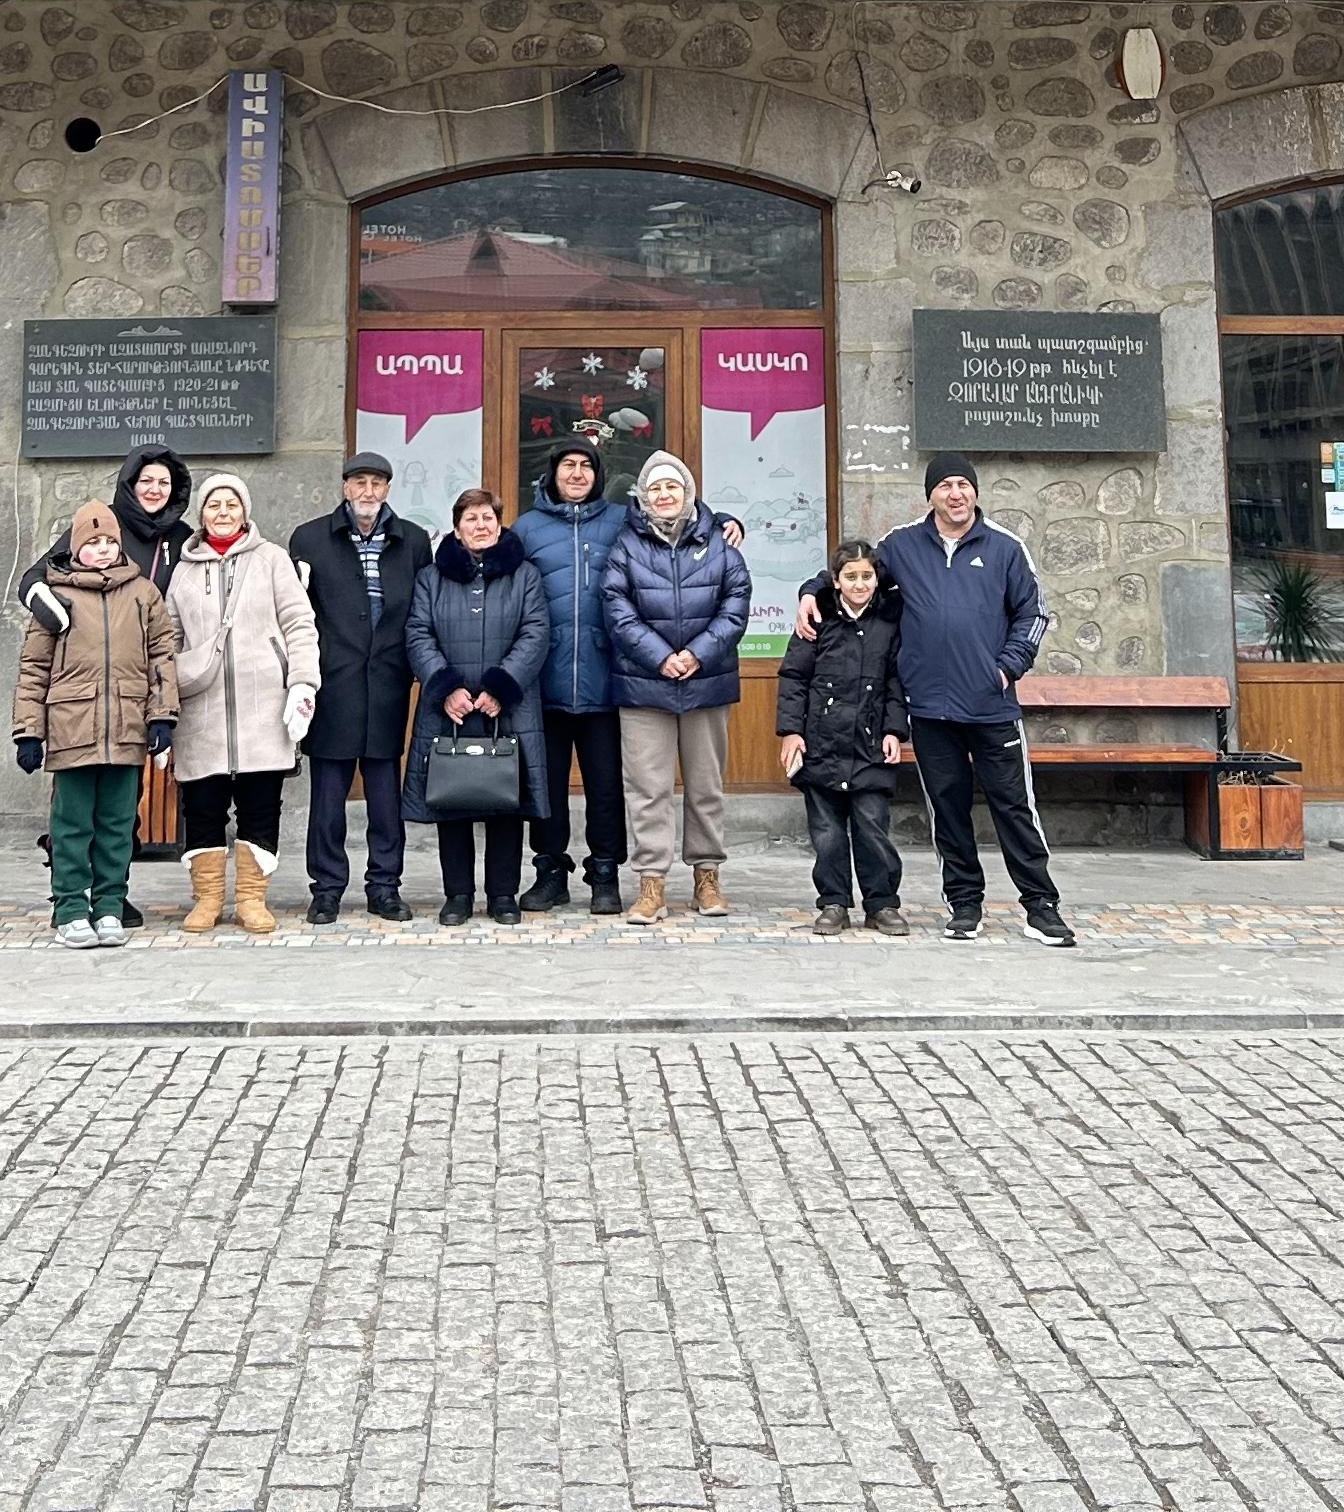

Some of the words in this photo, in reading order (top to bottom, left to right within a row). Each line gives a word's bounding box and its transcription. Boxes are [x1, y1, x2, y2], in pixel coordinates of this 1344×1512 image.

[960, 331, 990, 353] Այս
[996, 334, 1031, 349] տան
[375, 353, 464, 376] ԱՊՊԱ
[718, 351, 808, 373] ԿԱՍԿՈ
[28, 380, 51, 393] ԱՅՍ
[55, 380, 79, 393] ՏԱՆ
